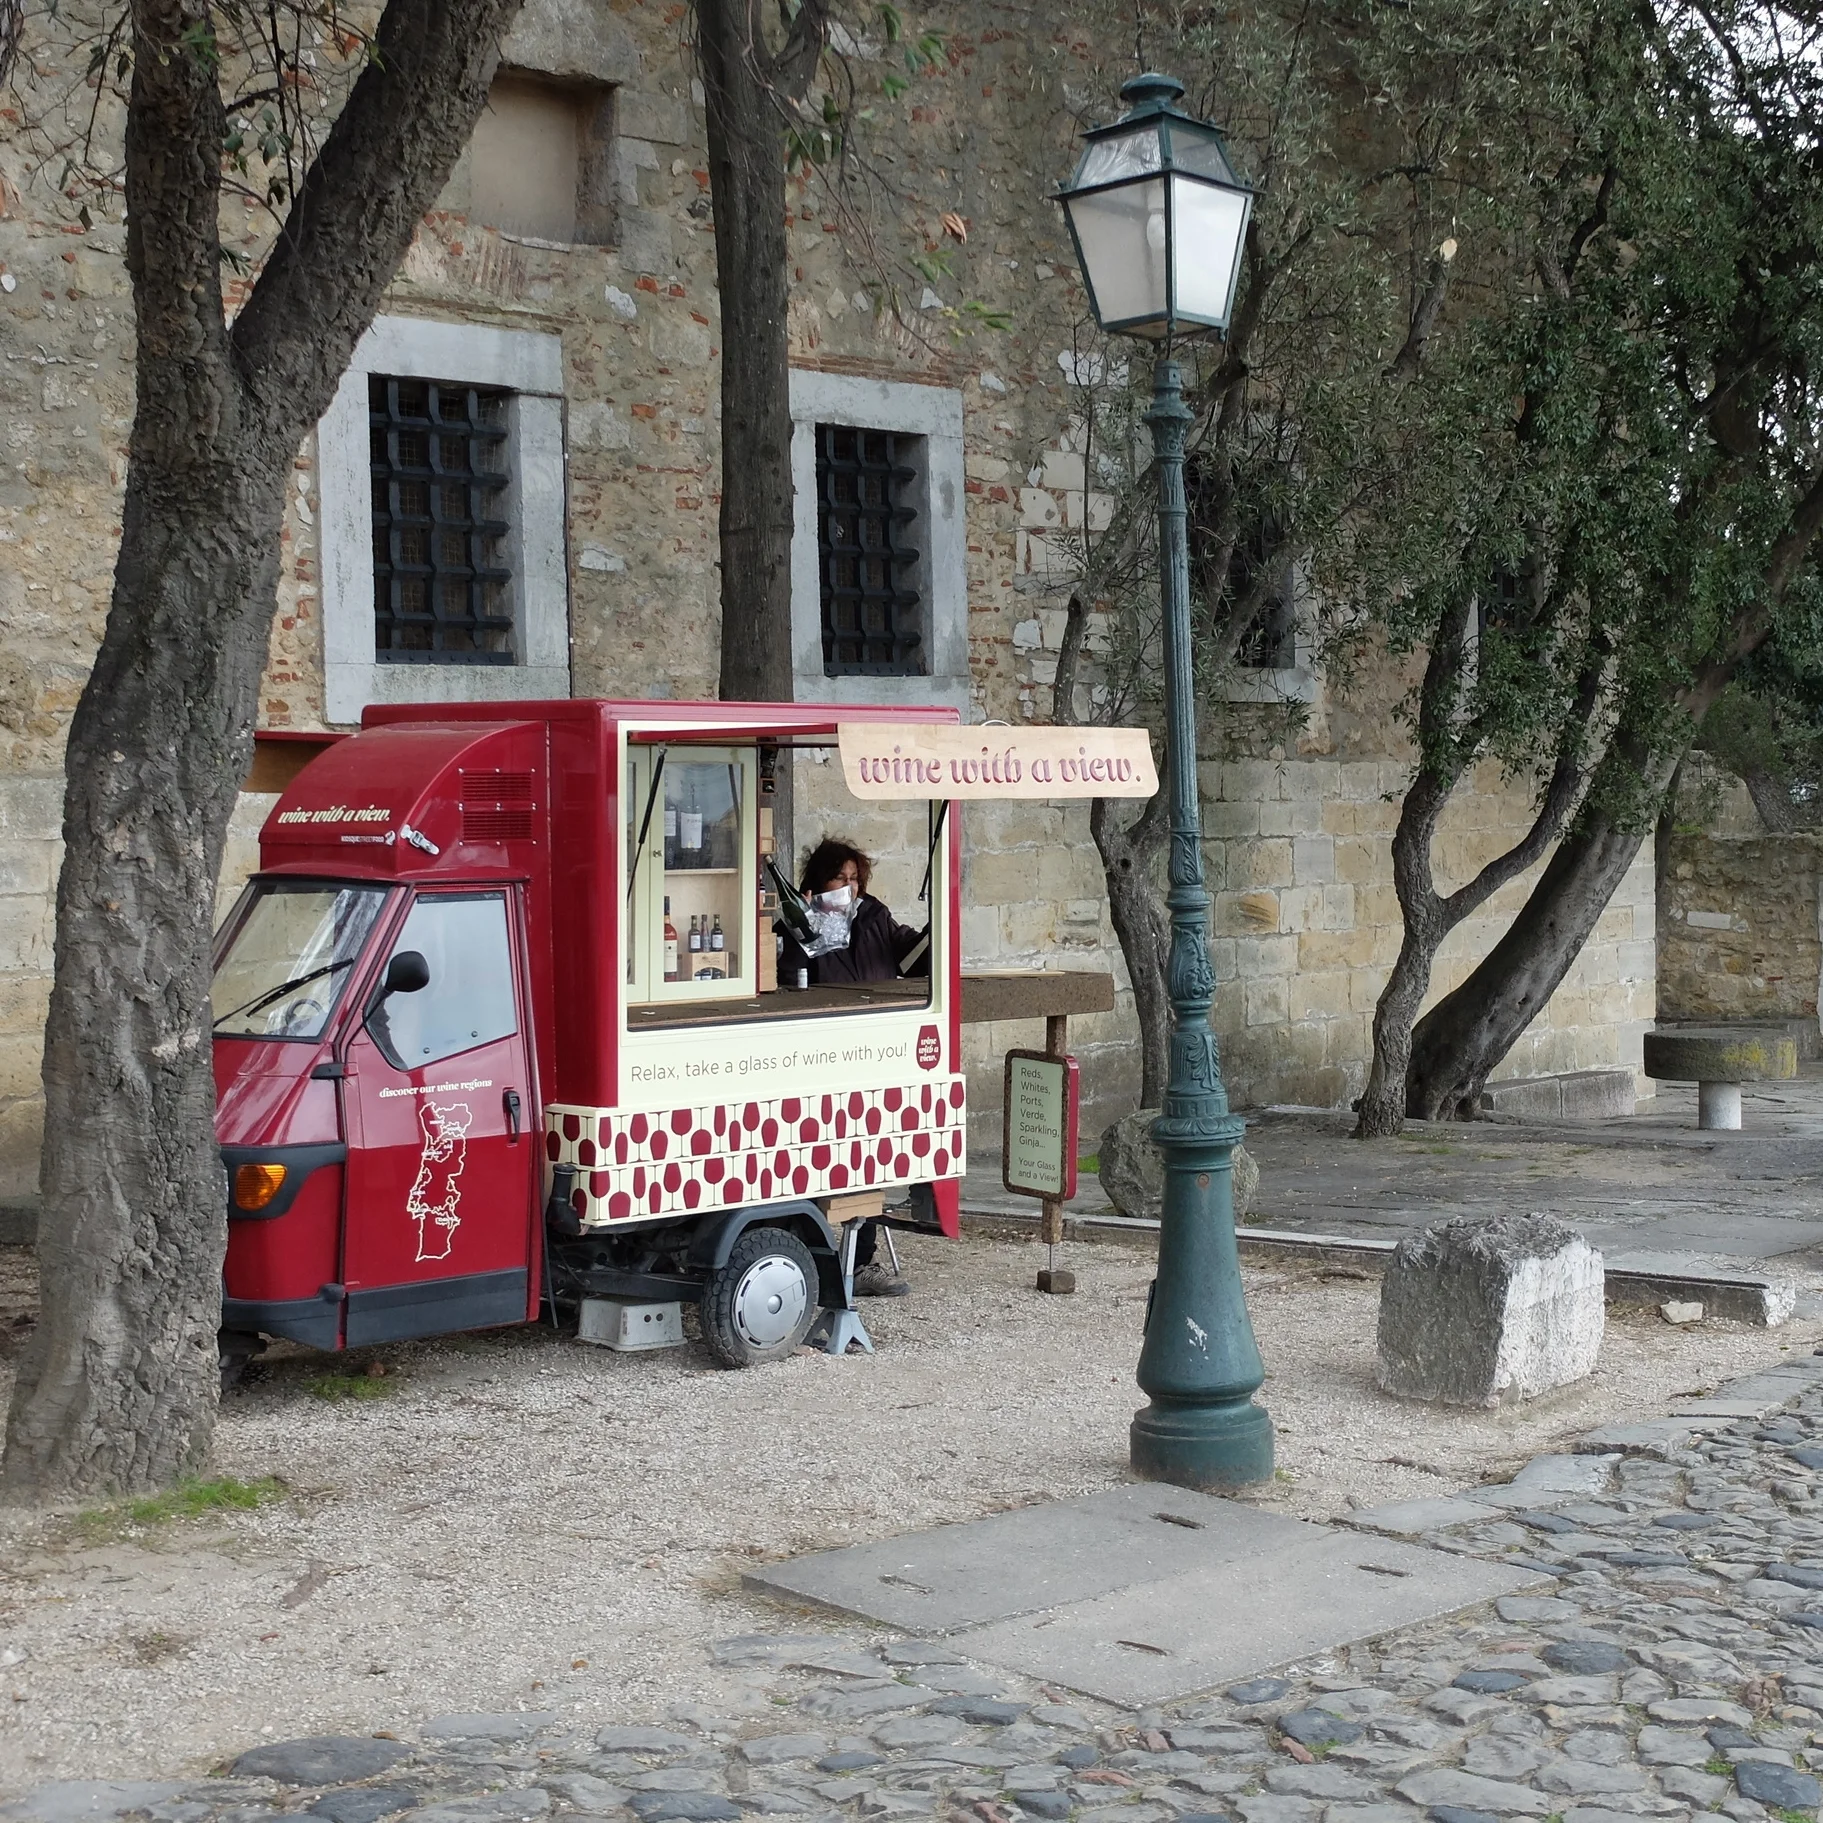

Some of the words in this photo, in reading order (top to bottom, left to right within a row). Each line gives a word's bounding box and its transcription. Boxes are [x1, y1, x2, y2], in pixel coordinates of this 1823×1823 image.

[858, 745, 942, 784] wine
[950, 746, 1022, 784] with
[1031, 757, 1053, 784] a
[1058, 746, 1142, 784] view.
[278, 806, 313, 824] wine
[311, 805, 347, 823] with
[342, 809, 356, 822] a
[354, 804, 391, 822] view.
[920, 1036, 937, 1046] wine
[918, 1045, 933, 1054] with
[631, 1064, 680, 1082] Relax,
[685, 1060, 720, 1077] take
[724, 1061, 733, 1074] a
[739, 1055, 777, 1075] glass
[782, 1051, 798, 1068] of
[802, 1049, 837, 1065] wine
[841, 1044, 873, 1061] with
[877, 1042, 907, 1062] you!
[1020, 1067, 1043, 1080] Reds,
[379, 1087, 419, 1098] discover
[419, 1085, 435, 1094] our
[437, 1081, 459, 1092] wine
[460, 1078, 493, 1092] regions
[1020, 1081, 1050, 1095] Whites,
[1020, 1094, 1044, 1107] Ports,
[1020, 1108, 1046, 1122] Verde,
[1019, 1121, 1060, 1138] Sparkling,
[1018, 1135, 1046, 1149] Ginja...
[1018, 1156, 1035, 1168] Your
[1036, 1160, 1056, 1171] Glass
[1018, 1170, 1032, 1179] and
[1032, 1172, 1038, 1180] a
[1039, 1172, 1059, 1183] View!
